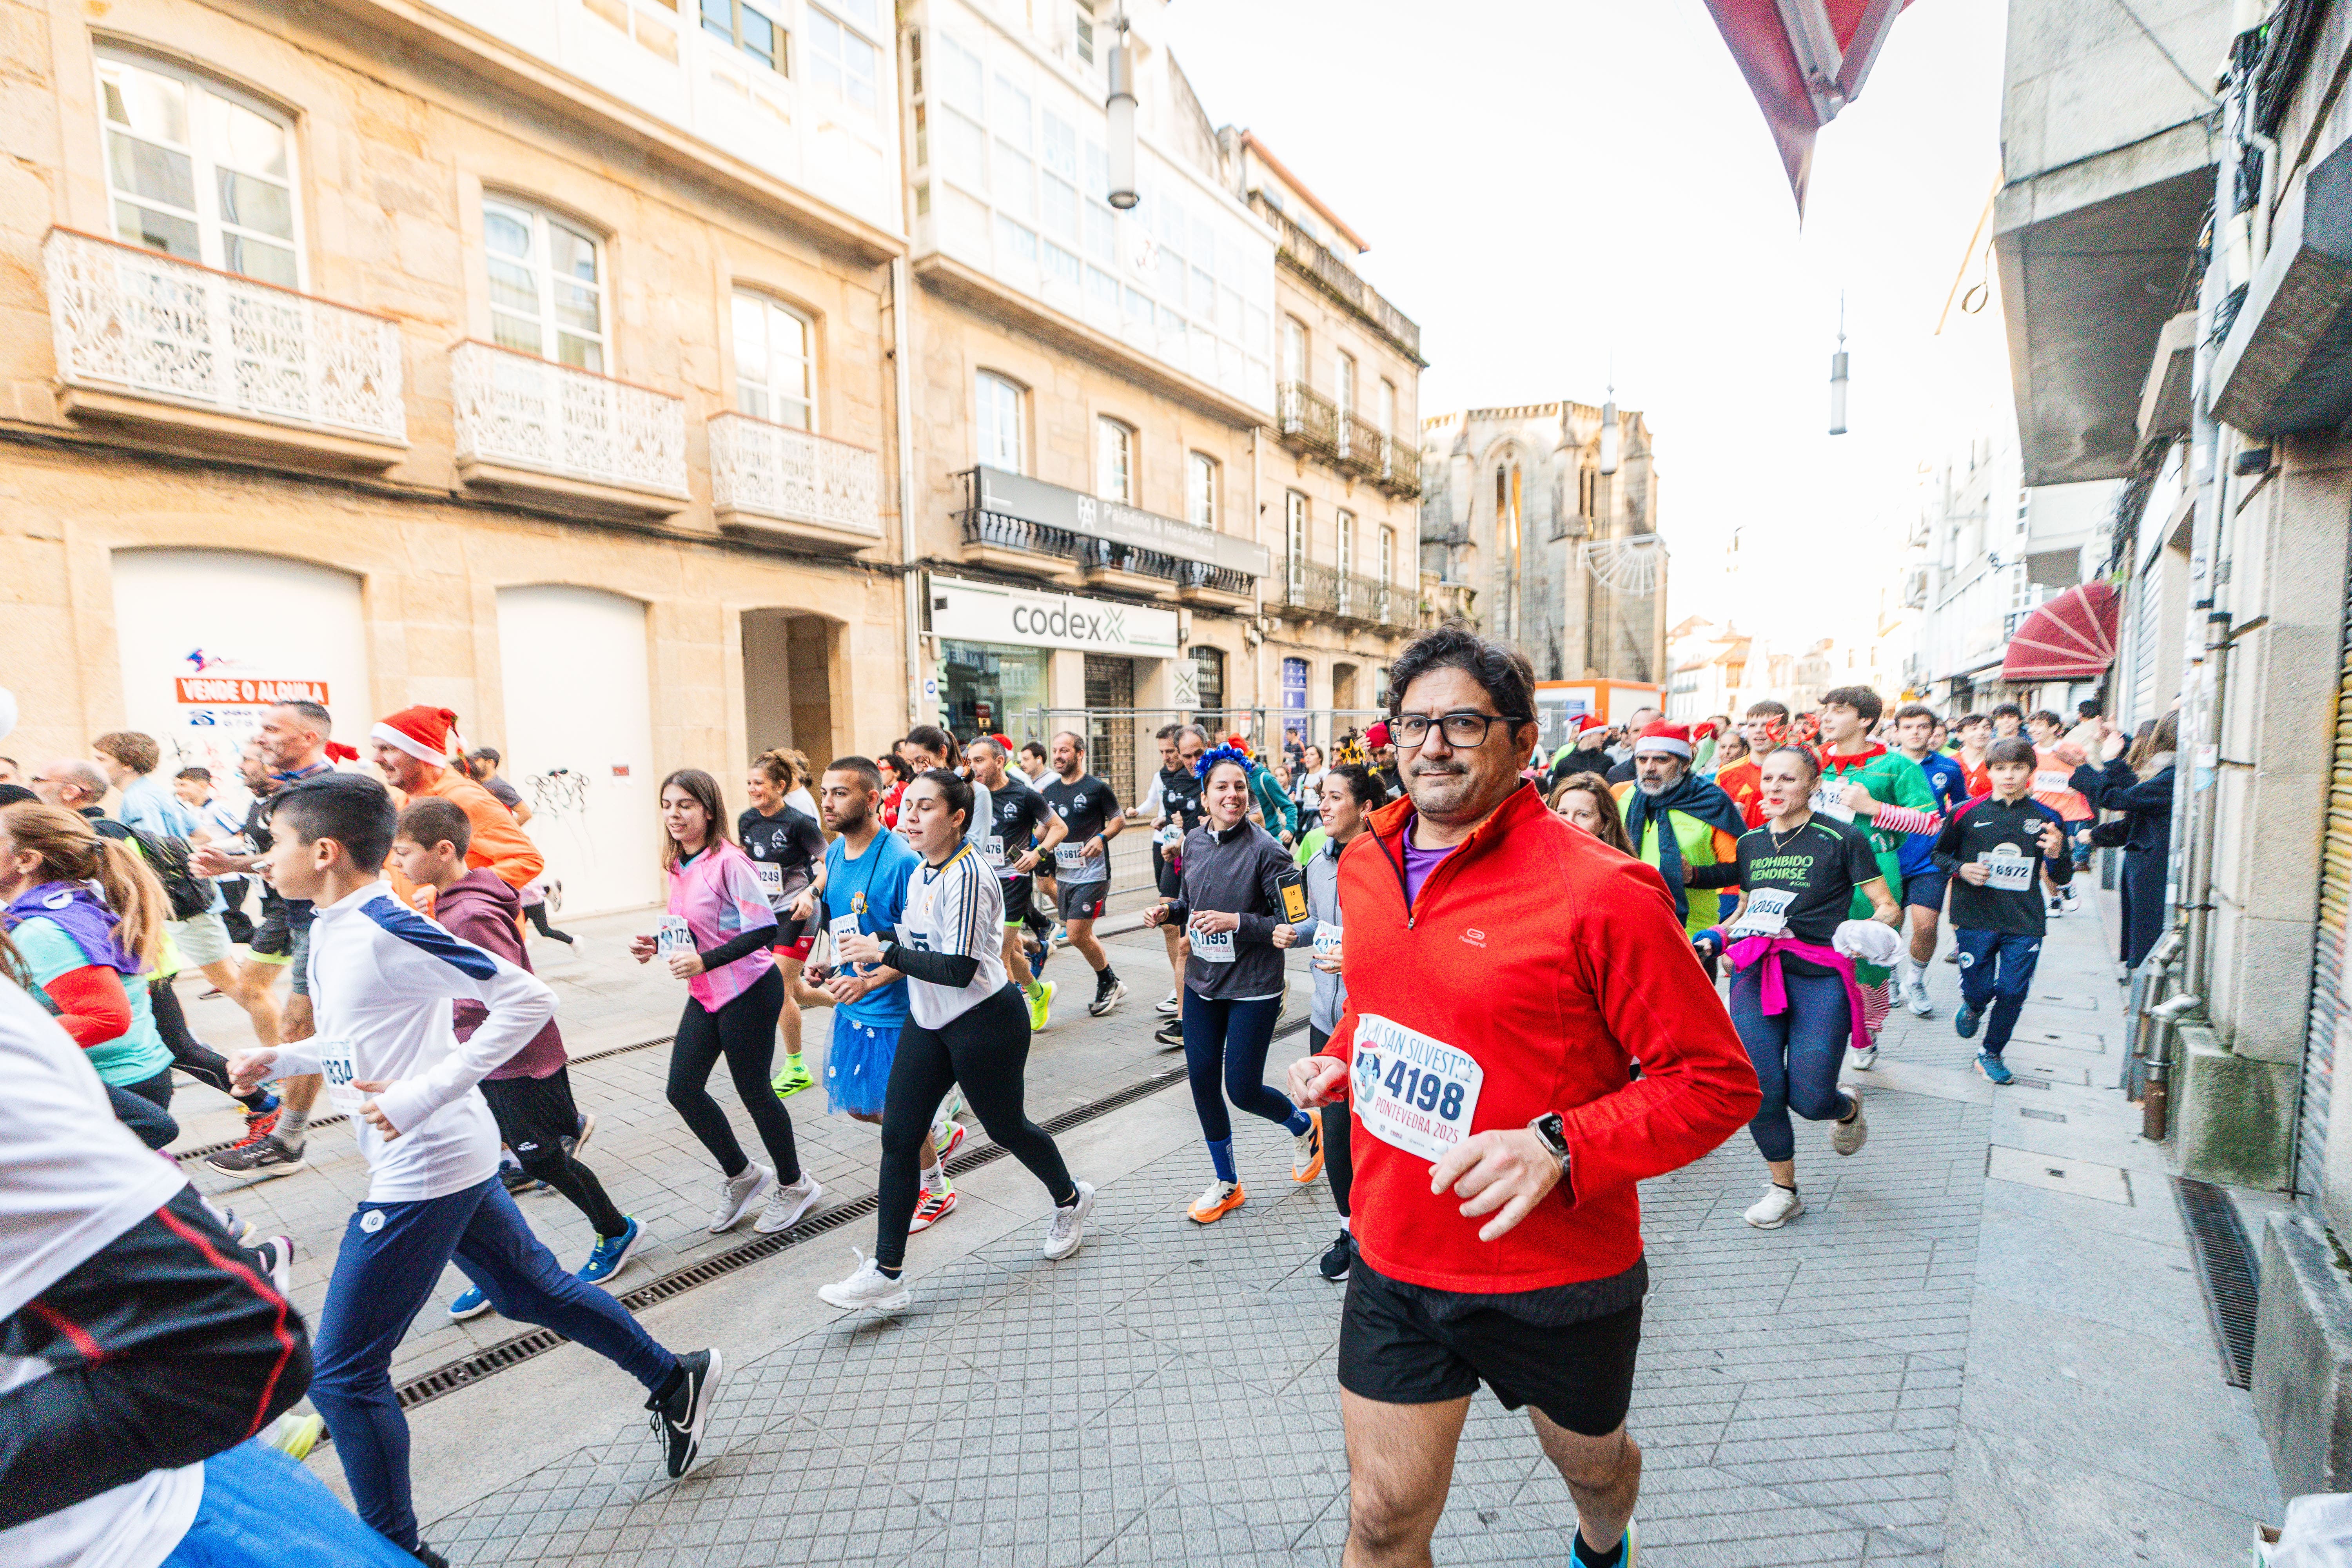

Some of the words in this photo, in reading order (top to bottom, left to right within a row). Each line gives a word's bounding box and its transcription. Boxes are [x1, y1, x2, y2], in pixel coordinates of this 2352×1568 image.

[1103, 503, 1151, 530] Paladino
[1153, 517, 1161, 534] &
[1165, 520, 1214, 547] Hernández
[1013, 600, 1101, 641] codex
[181, 679, 240, 701] VENDE
[241, 680, 256, 701] O
[258, 681, 325, 703] ALQUILA
[1750, 855, 1813, 869] PROHIBIDO
[1751, 867, 1808, 882] RENDIRSE
[1381, 1027, 1406, 1055] SAN
[1384, 1059, 1465, 1121] 4198
[1375, 1096, 1430, 1135] PONTEVEDRA
[1433, 1122, 1459, 1144] 2025
